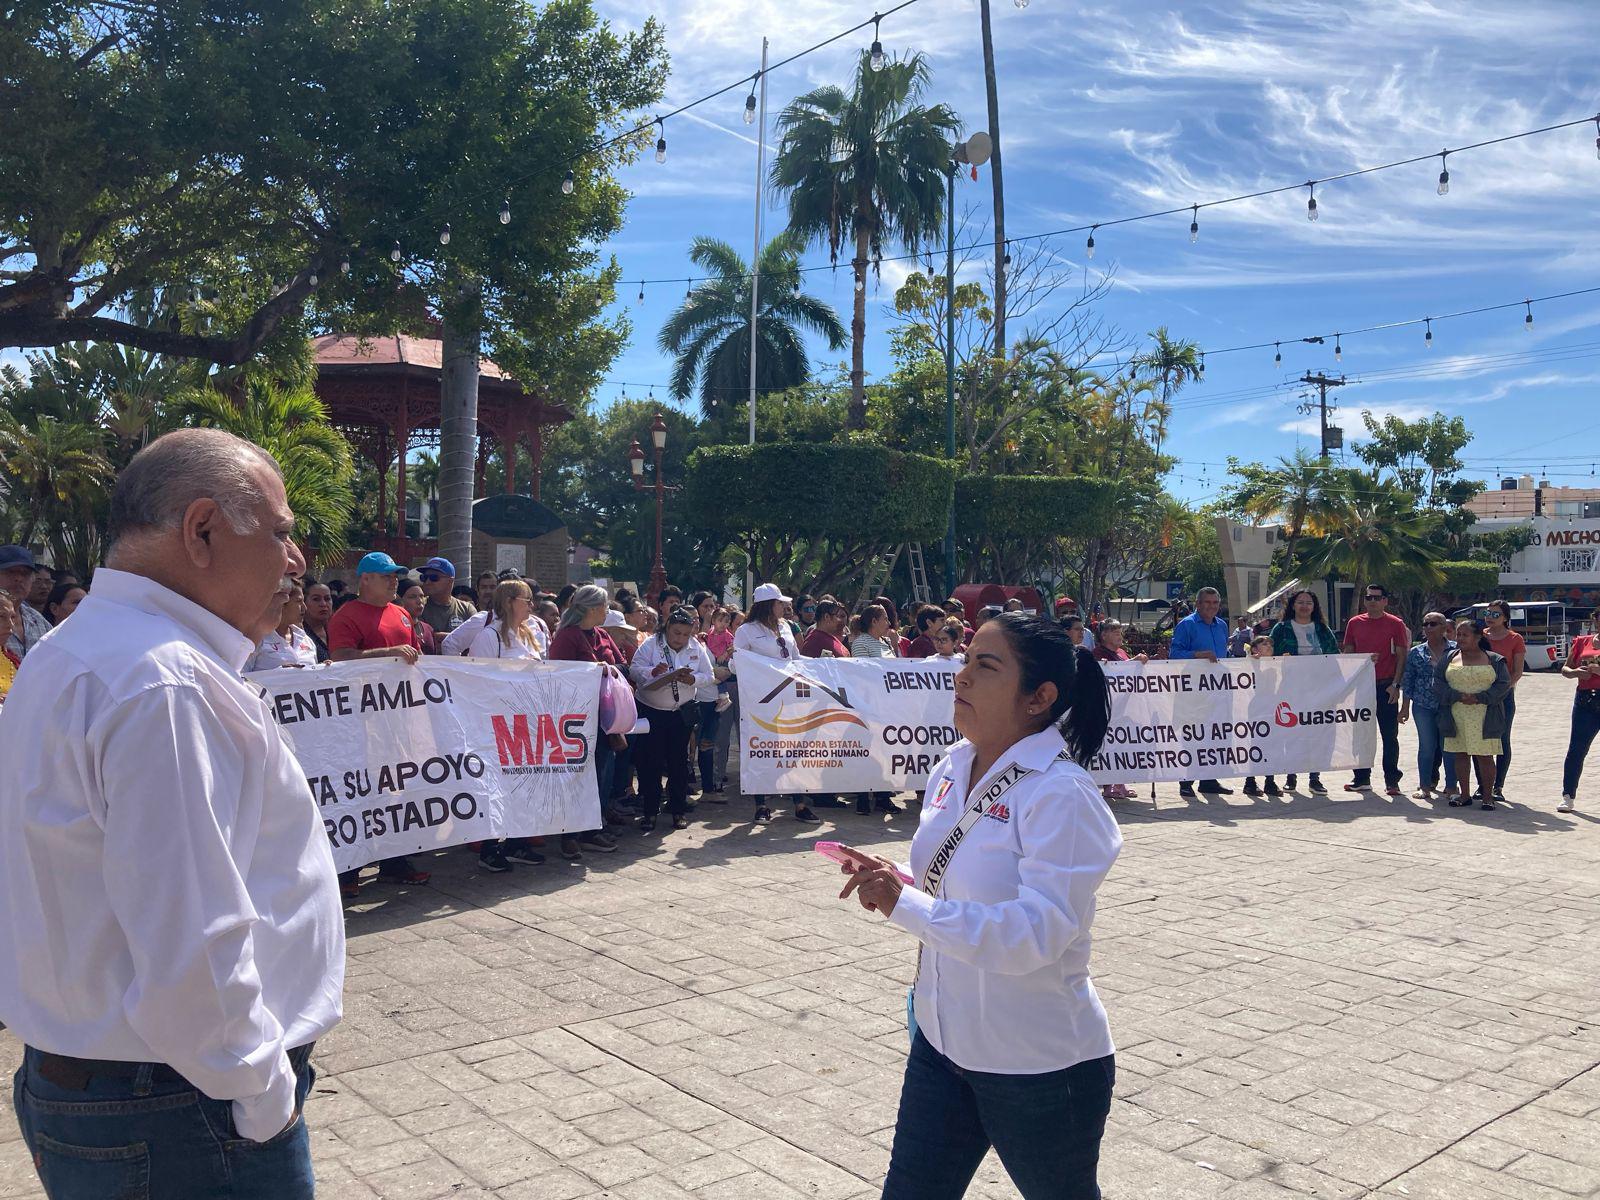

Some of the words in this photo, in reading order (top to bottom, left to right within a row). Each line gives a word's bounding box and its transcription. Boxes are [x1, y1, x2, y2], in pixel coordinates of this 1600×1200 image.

[1105, 674, 1193, 693] RESIDENTE
[1198, 672, 1256, 692] AMLO!
[271, 685, 353, 725] ENTE
[360, 678, 454, 713] AMLO!
[1274, 701, 1372, 728] Guasave
[491, 713, 588, 766] MAS
[749, 736, 827, 749] COORDINADORA
[829, 740, 863, 749] ESTATAL
[1106, 724, 1178, 744] SOLICITA
[1182, 723, 1205, 742] SU
[1211, 721, 1270, 740] APOYO
[749, 749, 771, 758] POR
[772, 749, 784, 758] EL
[786, 749, 829, 758] DERECHO
[830, 749, 870, 758] HUMANO
[776, 760, 783, 768] A
[786, 760, 798, 768] LA
[801, 759, 844, 768] VIVIENDA
[1091, 752, 1111, 771] EN
[1114, 750, 1193, 770] NUESTRO
[1198, 746, 1268, 767] ESTADO.
[344, 768, 372, 800] SU
[378, 752, 485, 794] APOYO
[362, 792, 484, 840] ESTADO.
